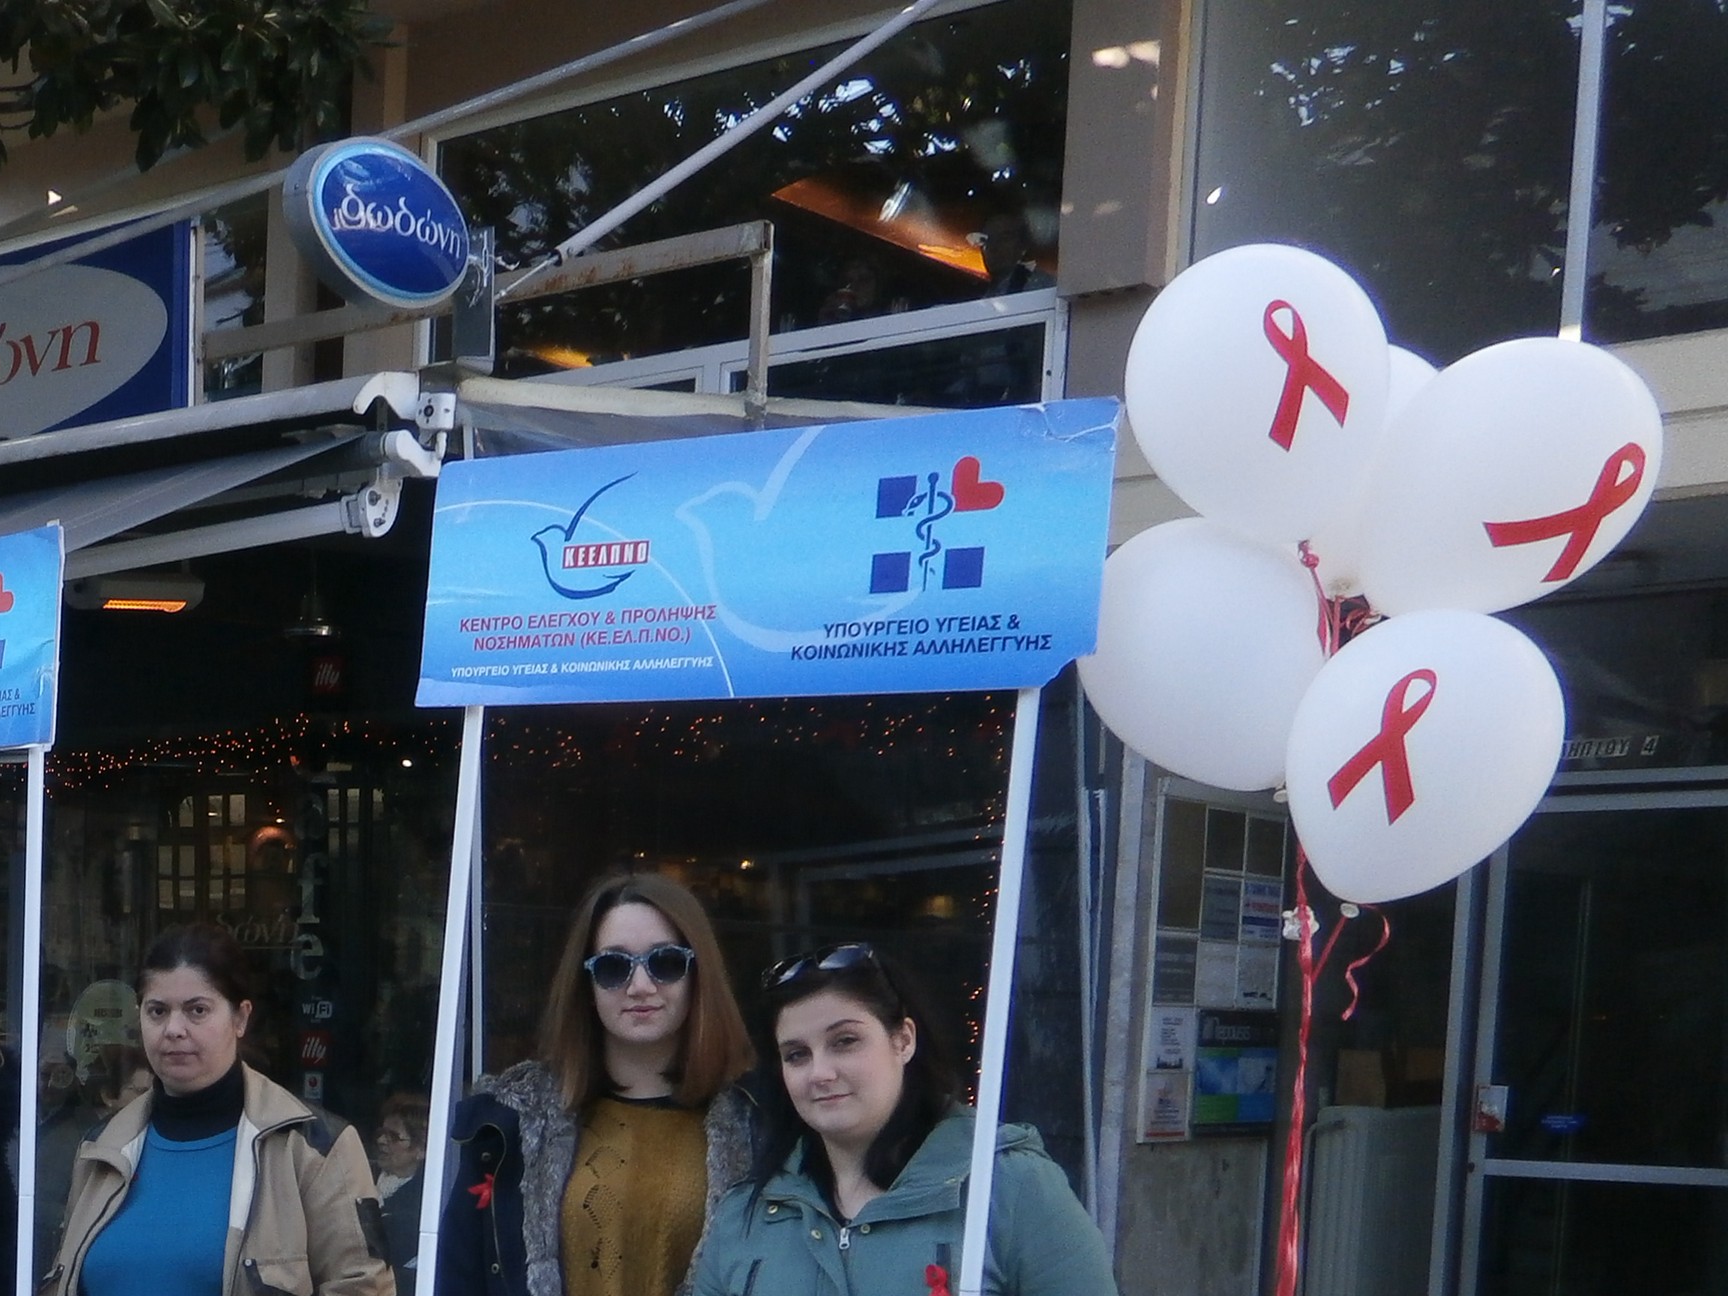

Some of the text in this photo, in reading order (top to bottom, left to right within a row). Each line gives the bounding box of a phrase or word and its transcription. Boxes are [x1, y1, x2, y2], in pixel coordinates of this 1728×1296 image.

[341, 183, 461, 259] δωδώνη
[564, 542, 648, 567] ΚΕΕΛΠΝΟ
[459, 605, 717, 632] ΚΕΝΤΡΟ ΕΛΕΓΧΟΥ & ΠΡΟΛΗΨΗΣ
[824, 613, 1020, 638] ΥΠΟΥΡΓΕΙΟ ΥΓΕΙΑΣ &
[473, 626, 691, 651] ΝΟΣΗΜΑΤΩΝ (ΚΕ.ΕΛ.Π.ΝΟ.)
[791, 635, 1052, 660] ΚΟΙΝΩΝΙΚΗΣ ΑΛΛΗΛΕΓΓΥΗΣ
[451, 655, 714, 678] ΥΠΟΥΡΓΕΙΟ ΥΓΕΙΑΣ & ΚΟΙΝΩΝΙΚΗΣ ΑΛΛΗΛΕΓΓΥΗΣ
[302, 1035, 327, 1064] illy
